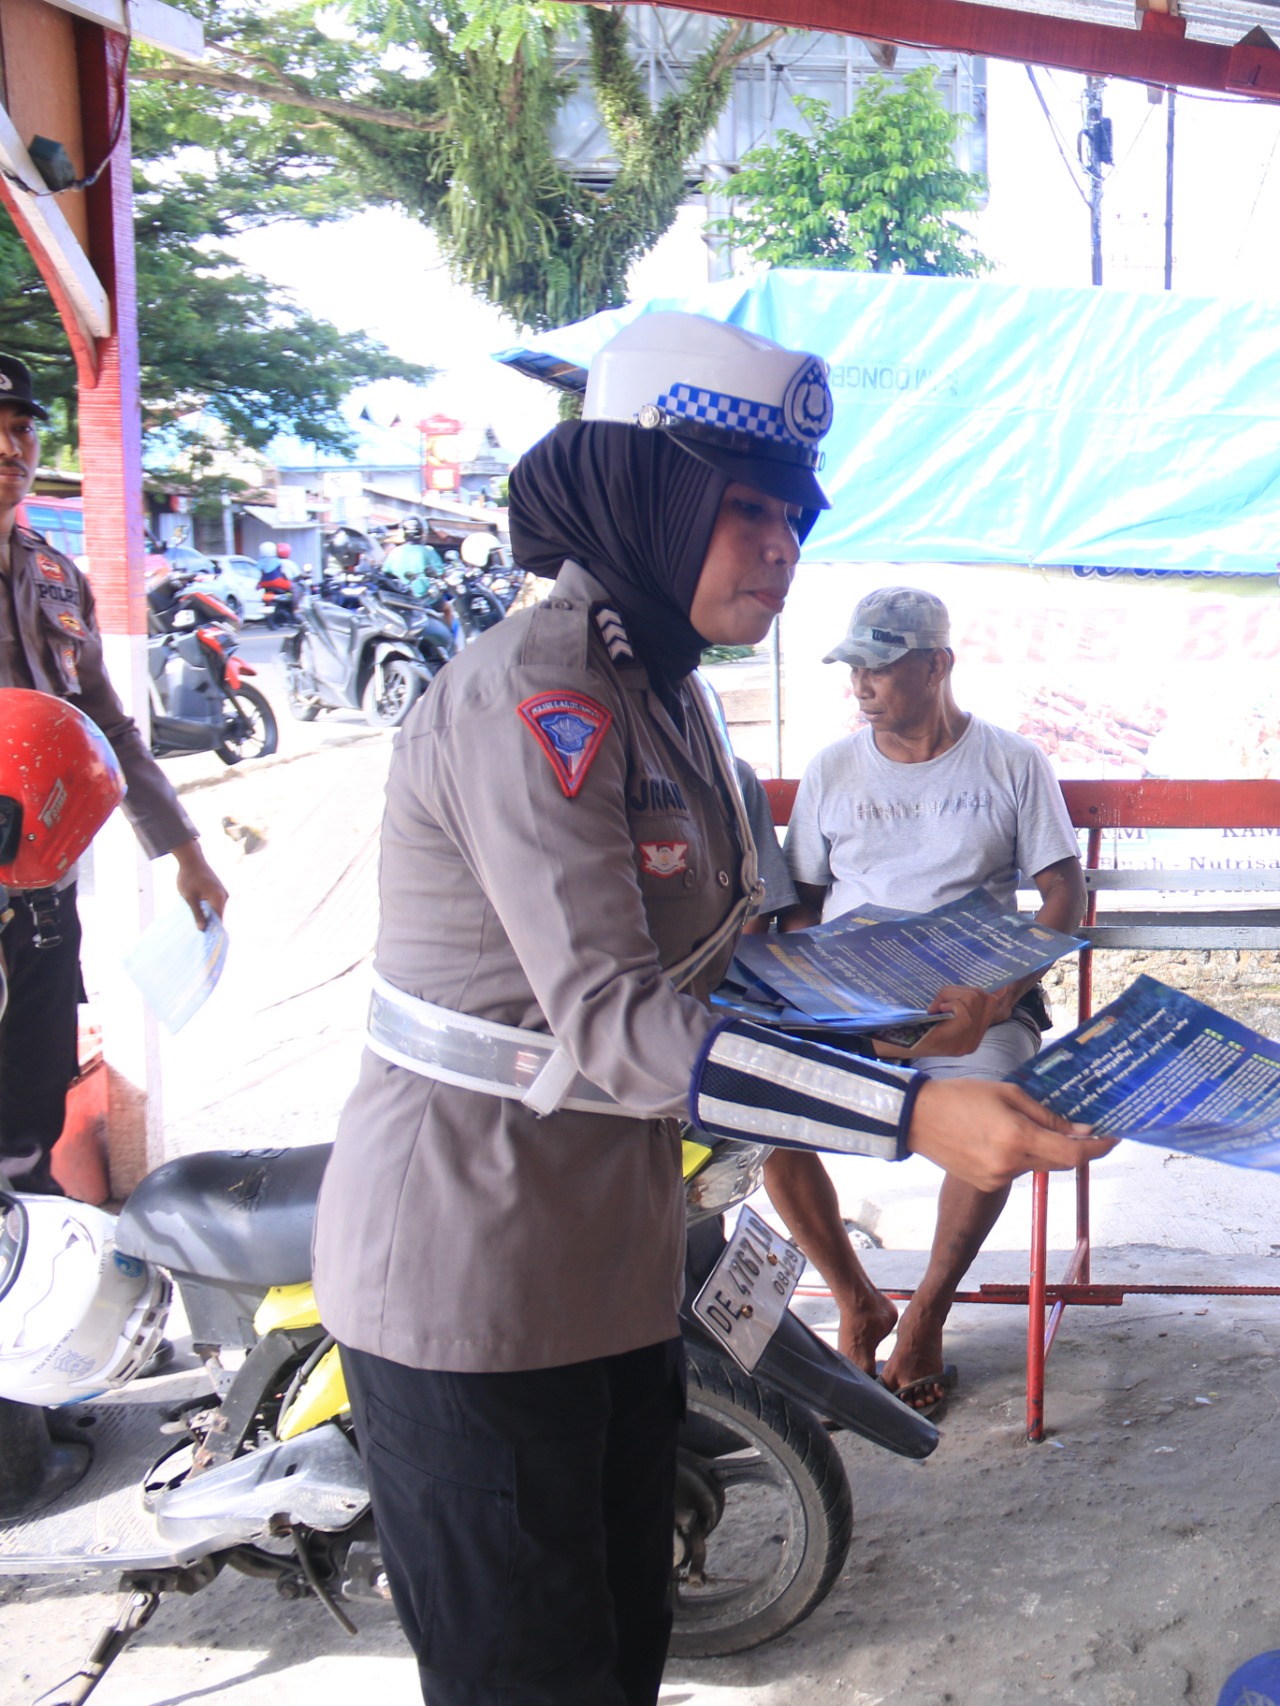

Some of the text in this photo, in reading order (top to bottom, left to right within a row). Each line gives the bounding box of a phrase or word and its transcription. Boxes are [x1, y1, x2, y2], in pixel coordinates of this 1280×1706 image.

[831, 364, 910, 391] DONGB
[955, 607, 1126, 664] ATE
[706, 1291, 742, 1335] DE
[728, 1237, 765, 1297] 4767
